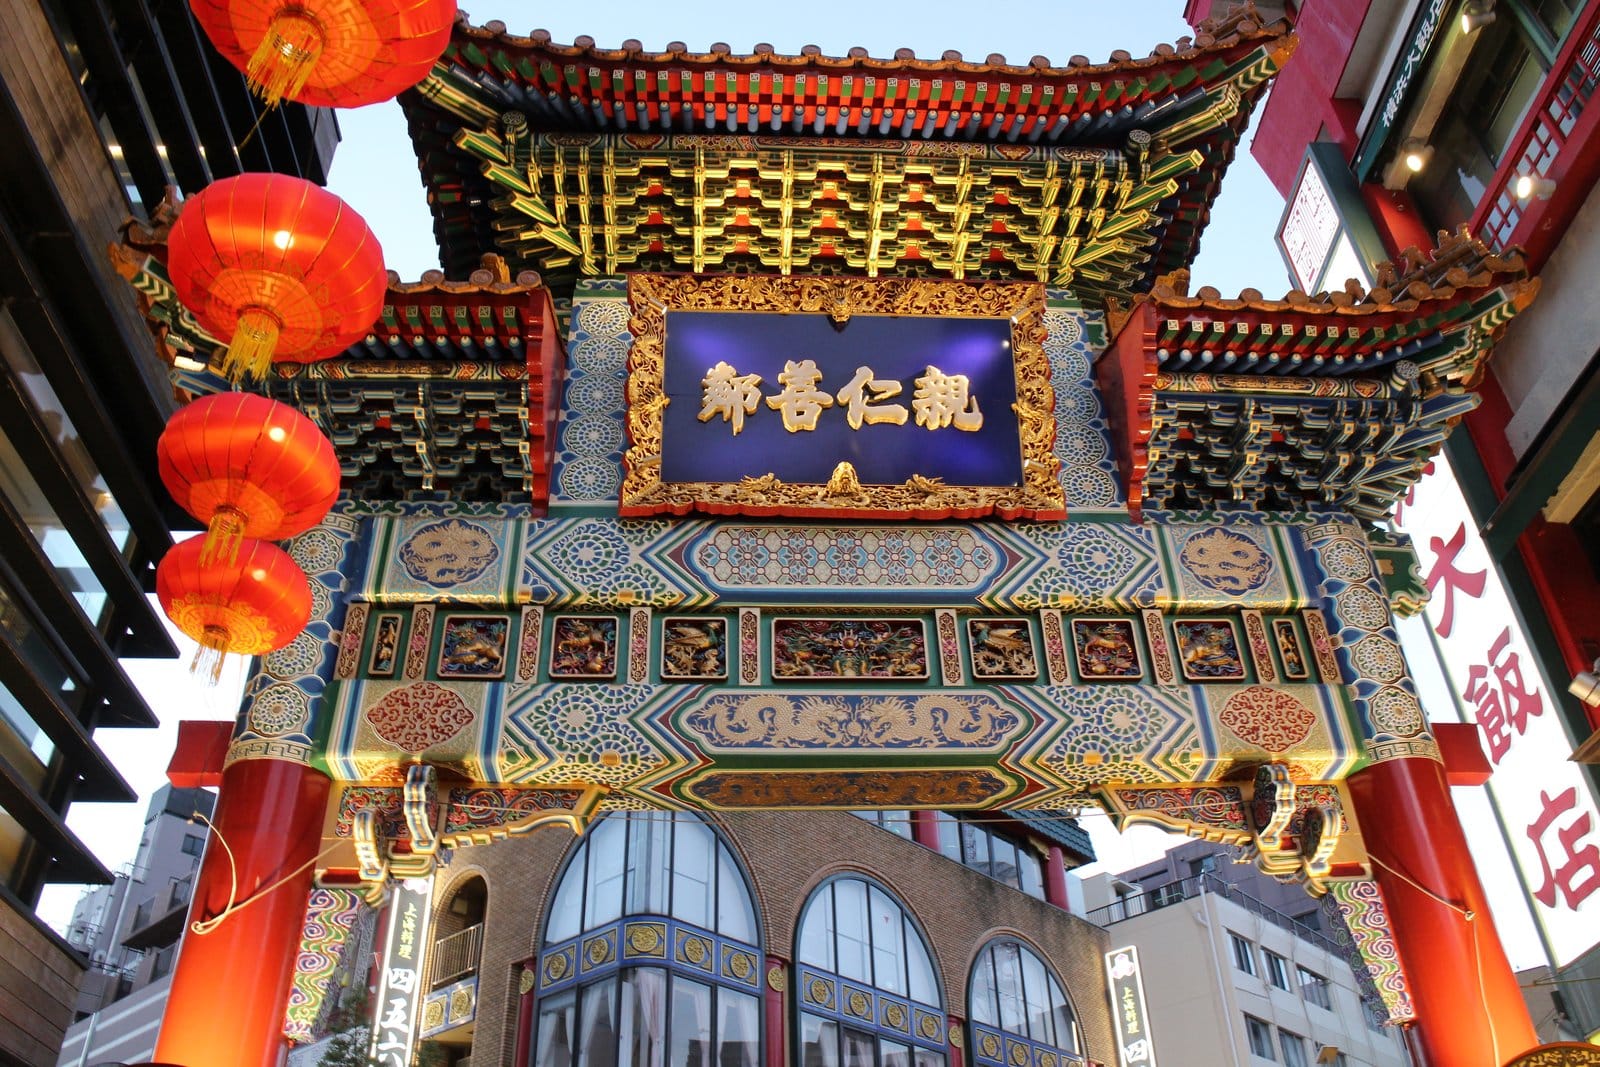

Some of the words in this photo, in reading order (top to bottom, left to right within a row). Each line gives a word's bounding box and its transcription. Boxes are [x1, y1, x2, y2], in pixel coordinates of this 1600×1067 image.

[1394, 461, 1600, 911] 大飯店
[378, 968, 416, 1067] 四五六
[1124, 1038, 1148, 1067] 四
